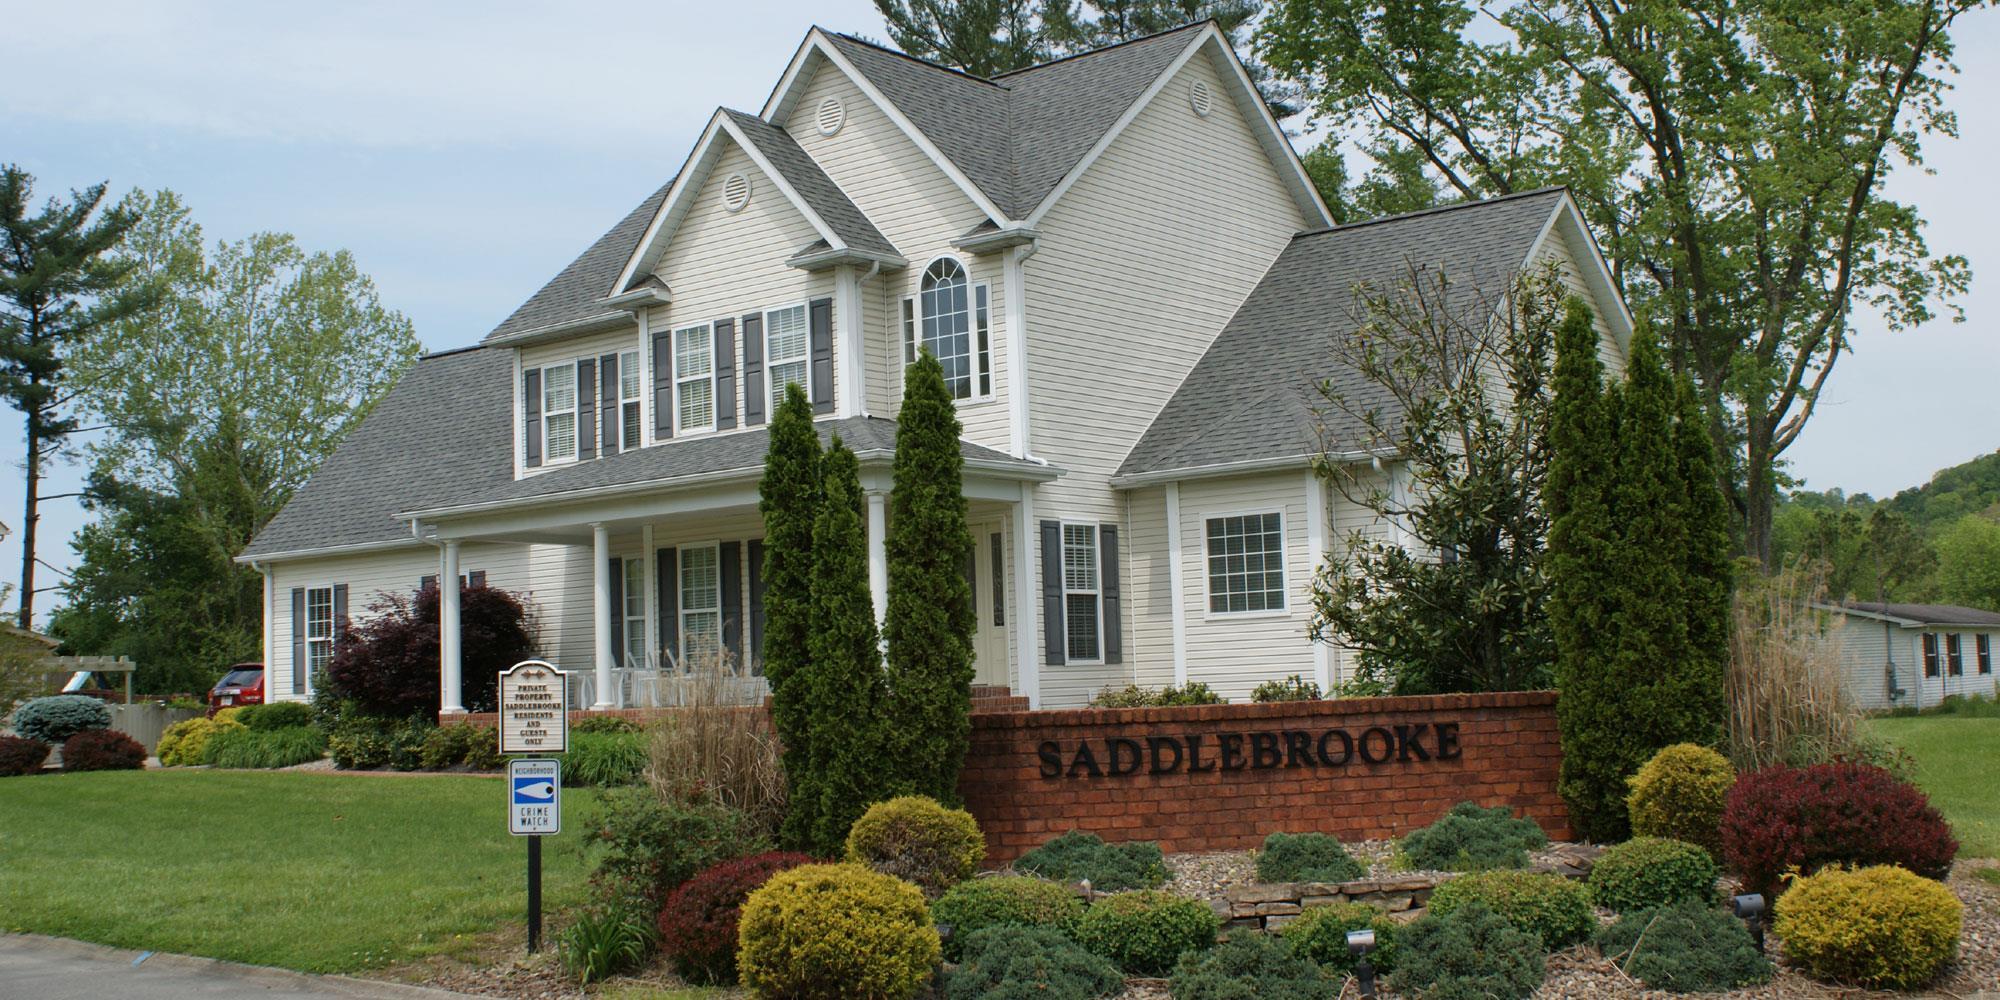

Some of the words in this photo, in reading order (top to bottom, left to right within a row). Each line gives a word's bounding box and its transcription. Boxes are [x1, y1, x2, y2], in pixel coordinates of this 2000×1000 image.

[515, 693, 552, 701] PROPERTY
[1037, 722, 1463, 779] SADDLEBROOKE
[515, 767, 554, 775] NEIGHBORHOOD
[520, 807, 548, 817] CRIME
[520, 817, 548, 826] WATCH
